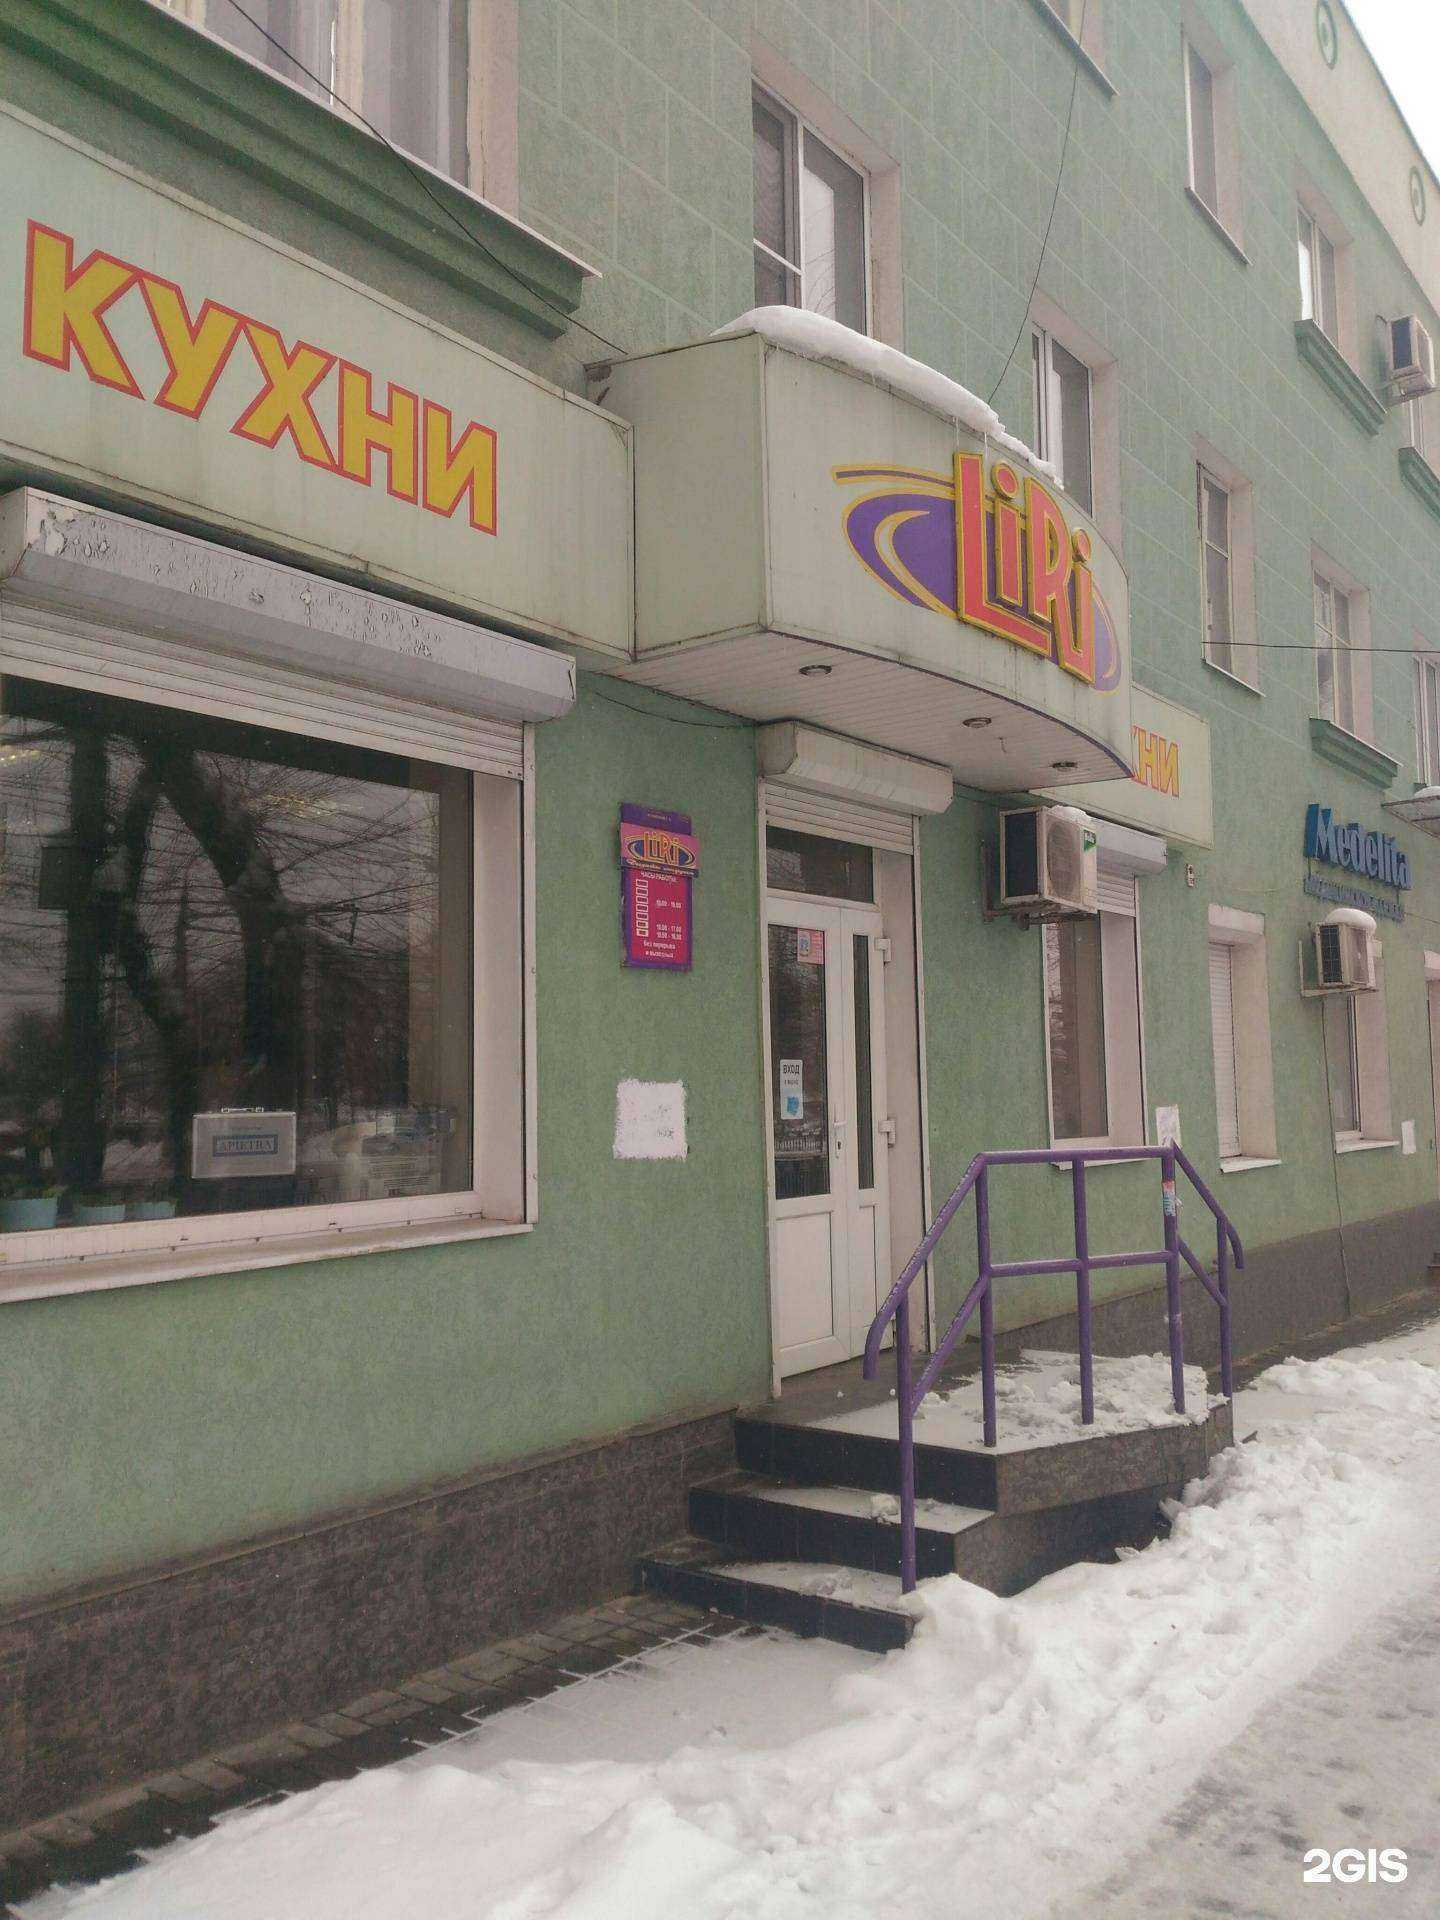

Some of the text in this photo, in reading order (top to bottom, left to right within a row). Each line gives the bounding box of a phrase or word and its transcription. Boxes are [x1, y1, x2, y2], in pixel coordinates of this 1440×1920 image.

[23, 218, 498, 537] КУХНИ
[1130, 724, 1180, 798] НИ
[783, 1064, 800, 1075] ВХОД
